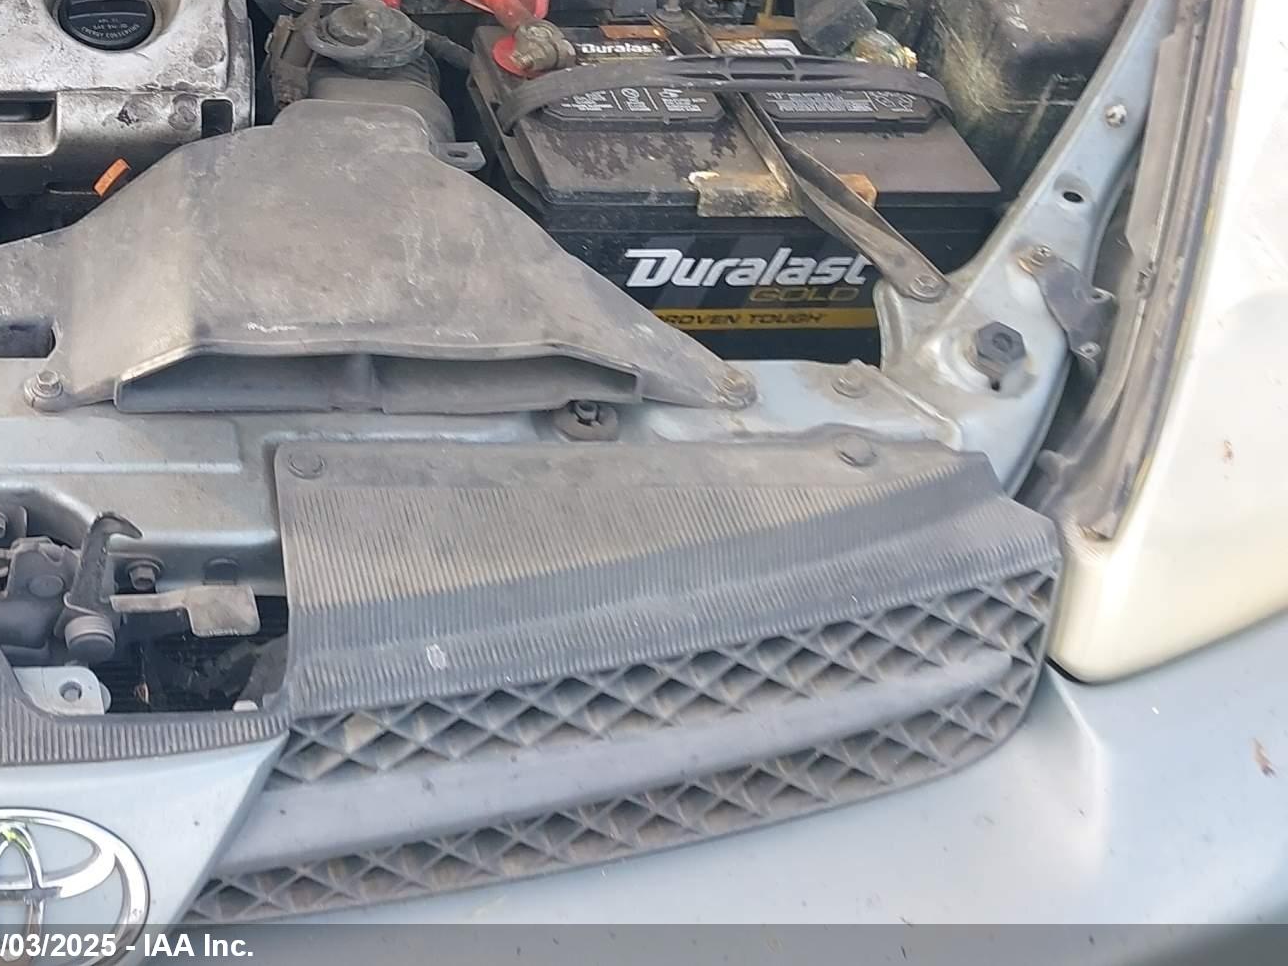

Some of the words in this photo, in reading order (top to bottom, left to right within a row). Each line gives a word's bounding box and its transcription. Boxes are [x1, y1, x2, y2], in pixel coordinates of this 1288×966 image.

[624, 247, 873, 288] Duralast
[749, 287, 860, 303] GOLD
[749, 314, 821, 325] TOUGH
